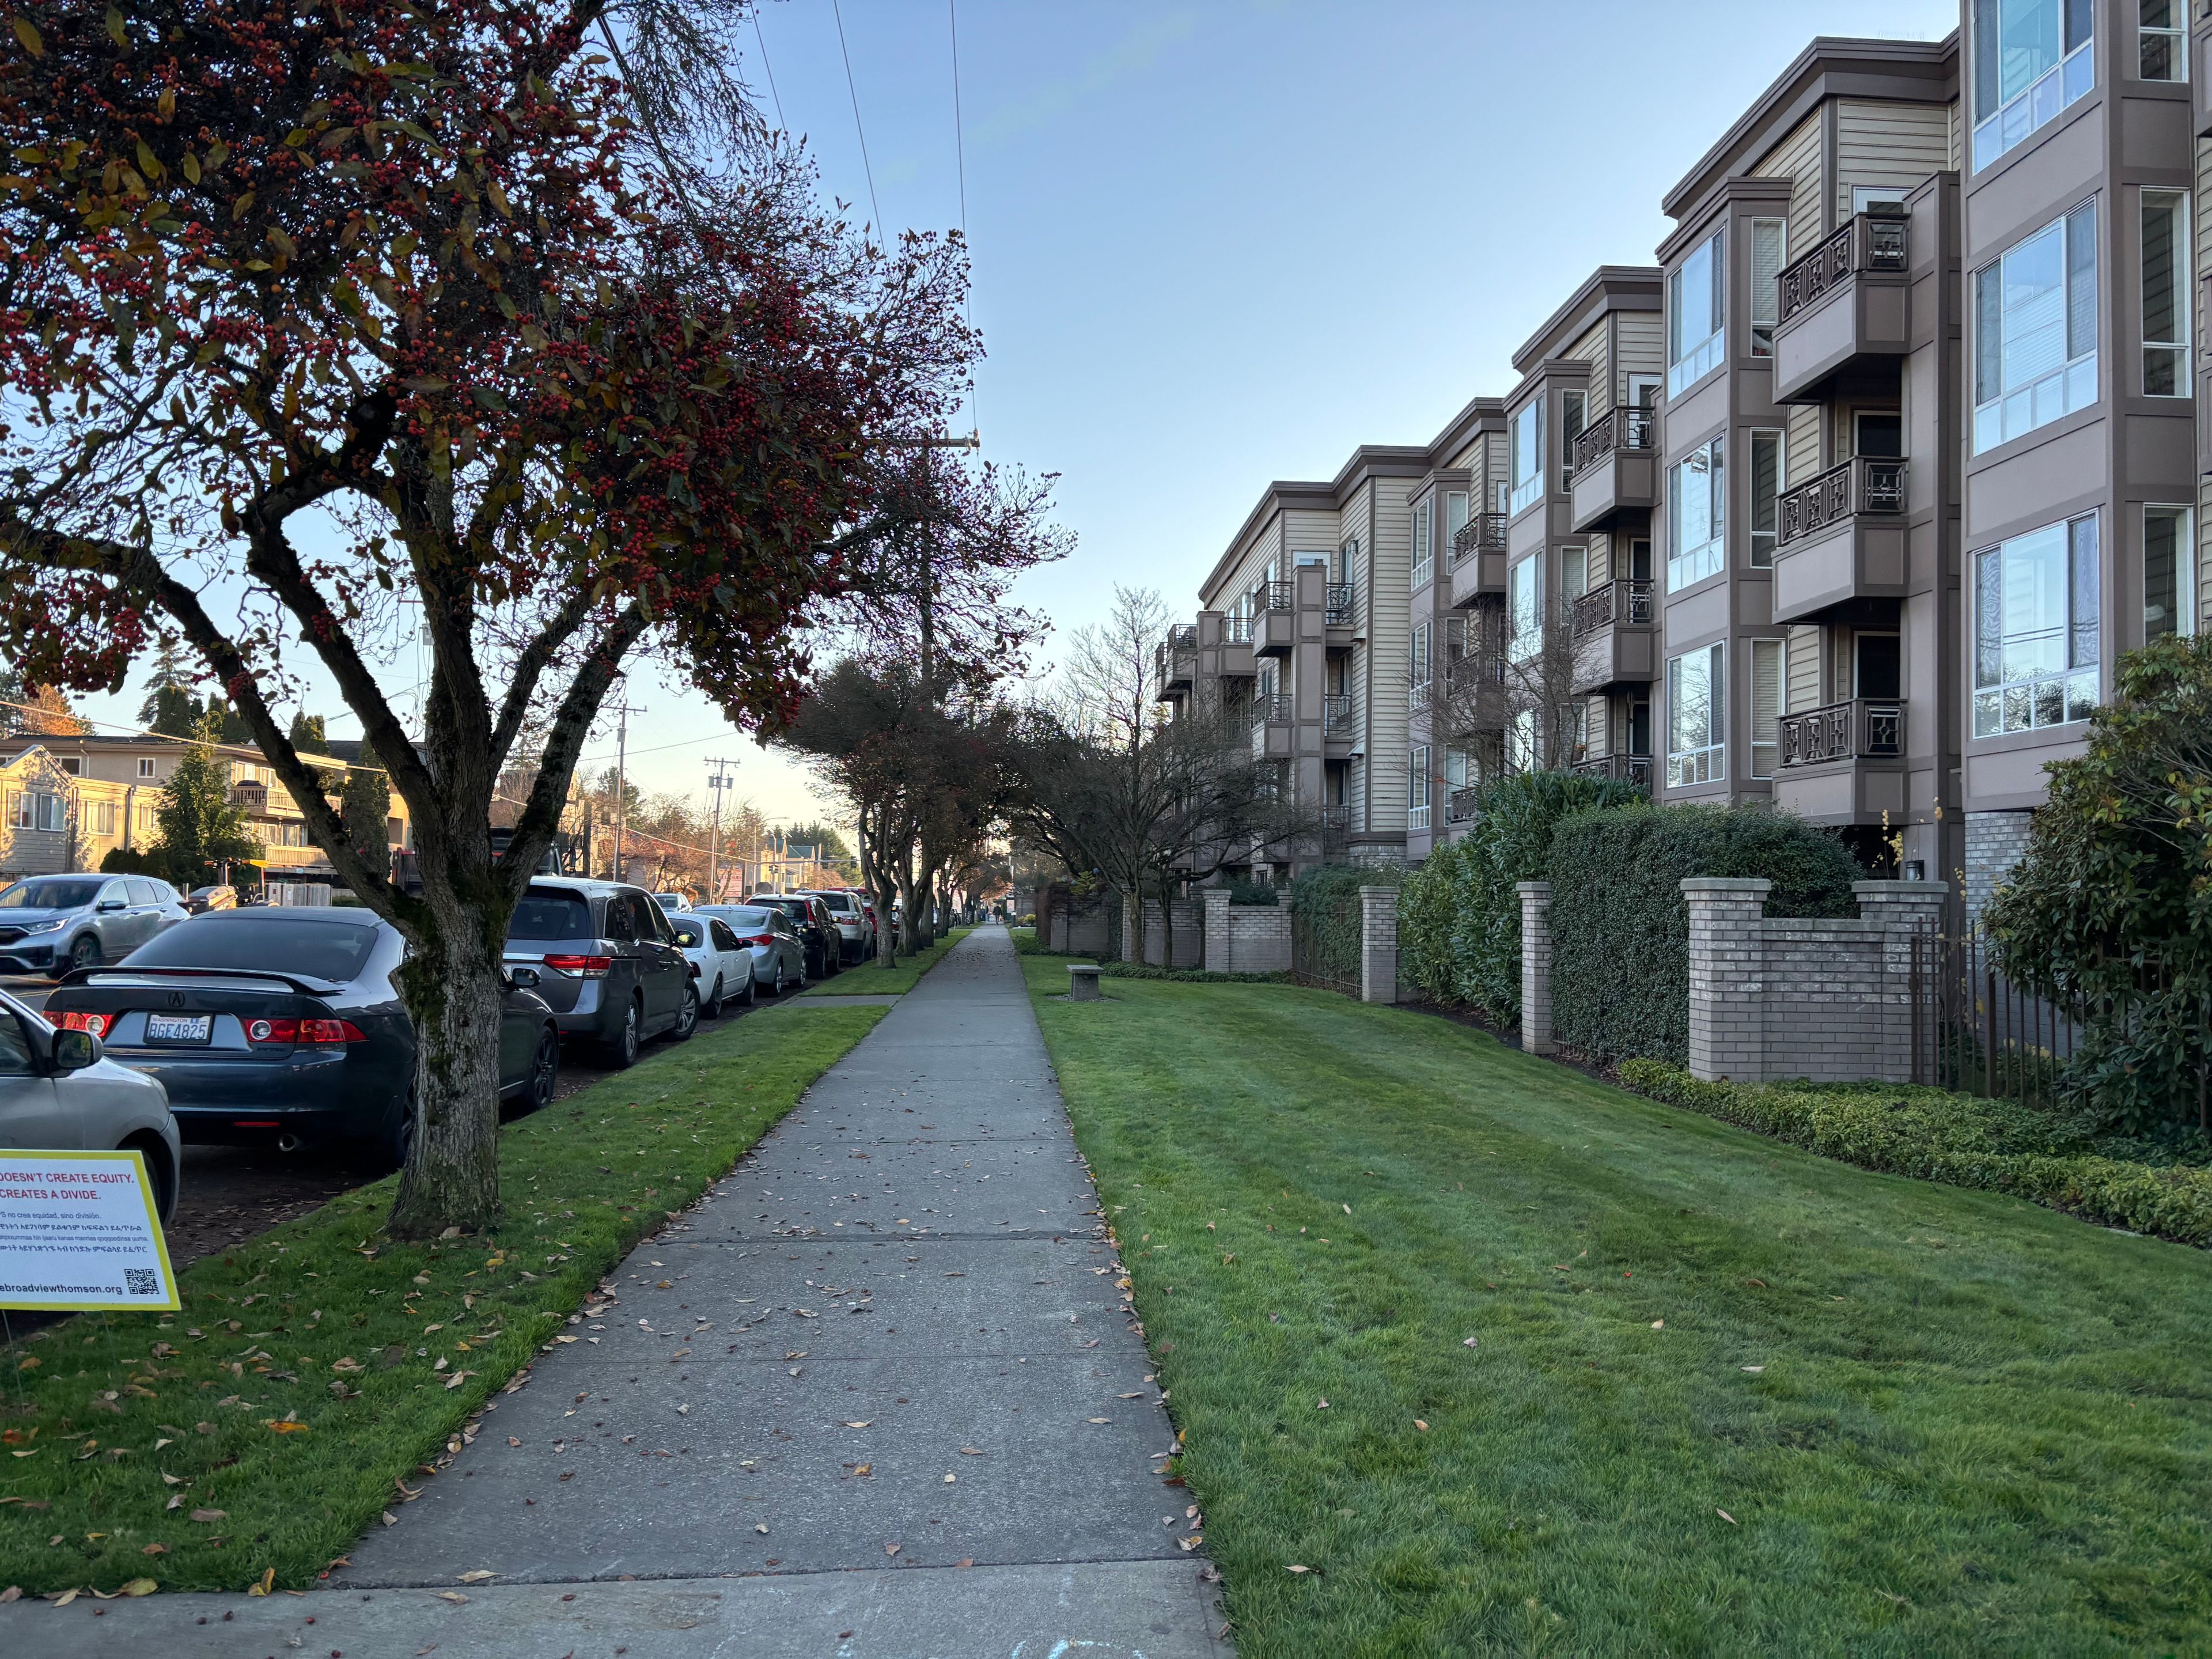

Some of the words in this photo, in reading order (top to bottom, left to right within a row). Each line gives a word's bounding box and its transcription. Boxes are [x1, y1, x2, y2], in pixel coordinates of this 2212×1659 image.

[46, 1173, 90, 1183] CREATE
[91, 1173, 135, 1183] EQUITY.
[0, 1189, 48, 1199] CREATES
[51, 1190, 59, 1199] A
[60, 1190, 101, 1199] DIVIDE.
